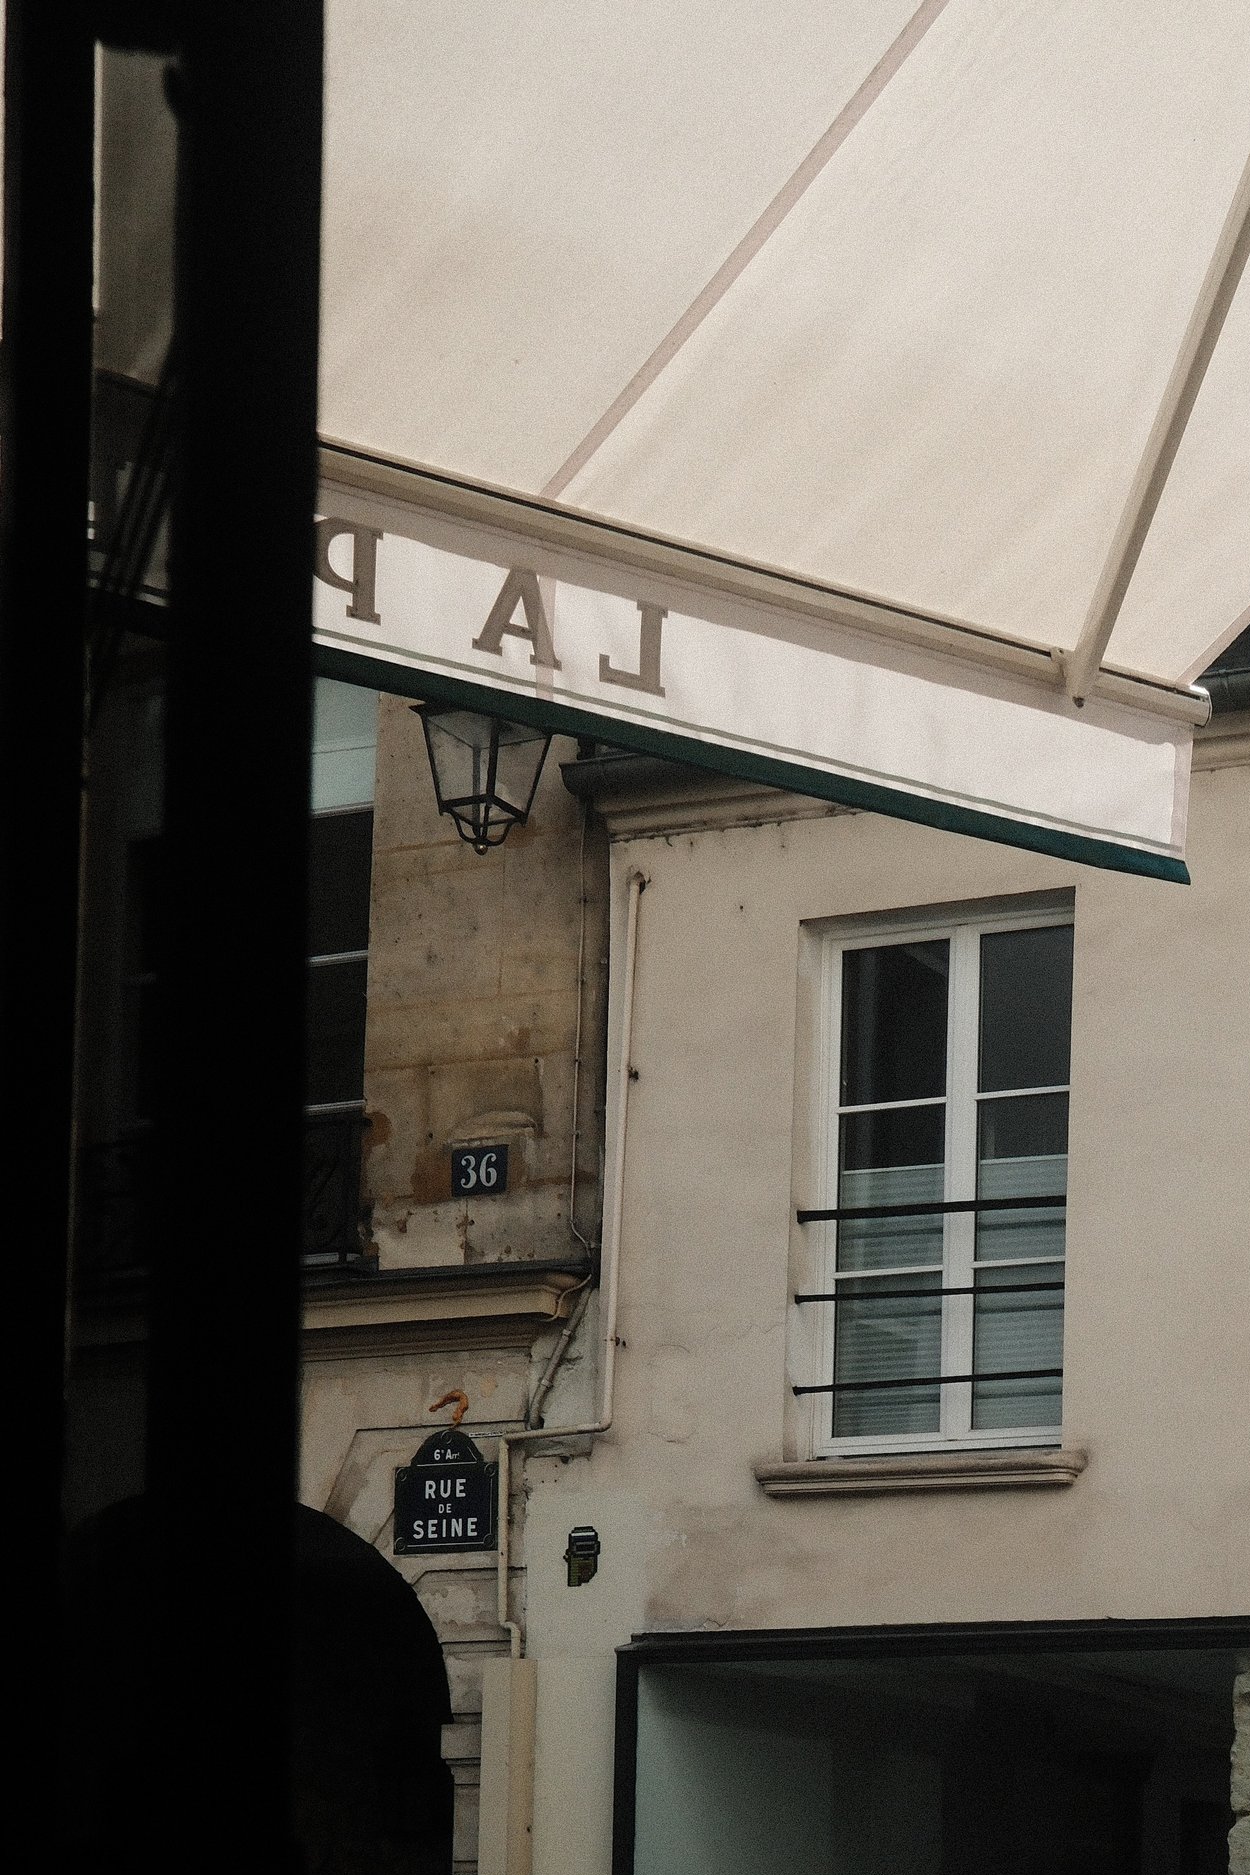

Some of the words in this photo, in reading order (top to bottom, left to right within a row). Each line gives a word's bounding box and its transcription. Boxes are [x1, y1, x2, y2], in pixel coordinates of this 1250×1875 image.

[460, 1152, 498, 1190] 36
[425, 1478, 467, 1499] RUE
[438, 1503, 452, 1514] DE
[412, 1517, 478, 1539] SEINE
